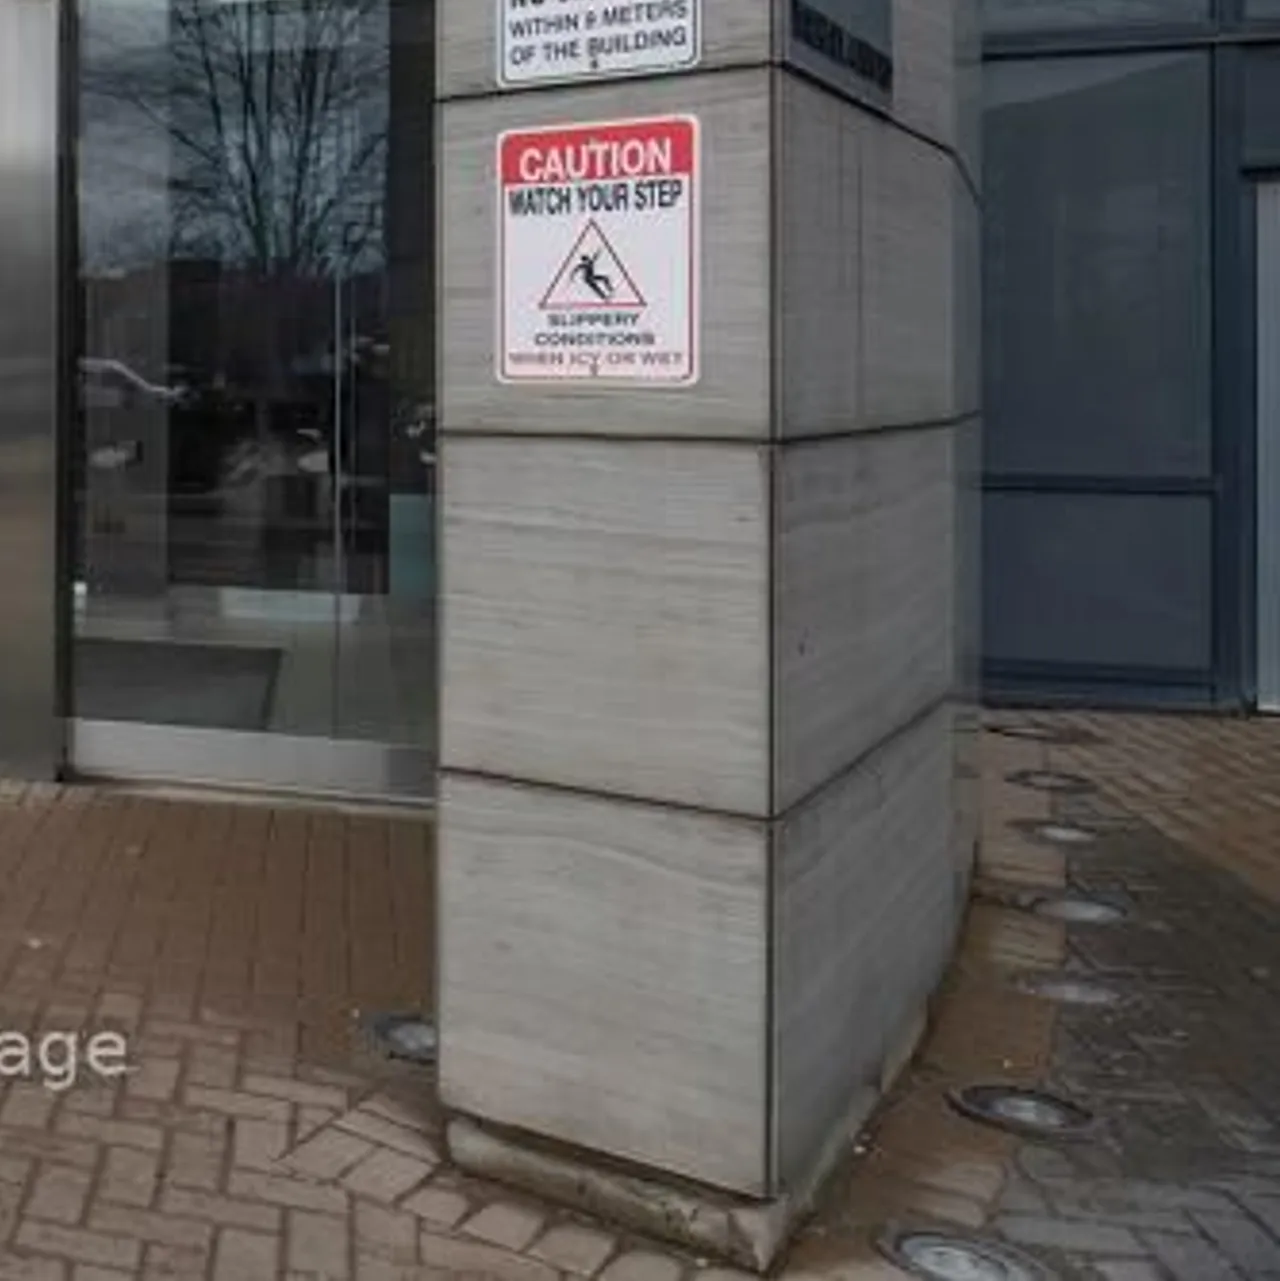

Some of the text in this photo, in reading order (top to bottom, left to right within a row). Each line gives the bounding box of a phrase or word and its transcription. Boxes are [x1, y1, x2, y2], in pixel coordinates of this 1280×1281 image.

[509, 14, 578, 38] WITHIN
[510, 26, 687, 65] OF THE BUILDING
[519, 138, 672, 182] CAUTION
[509, 179, 683, 216] WATCH YOUR STEP
[547, 313, 639, 327] SLIPPERY
[534, 332, 655, 346] CONDITIONS
[641, 352, 683, 365] WET
